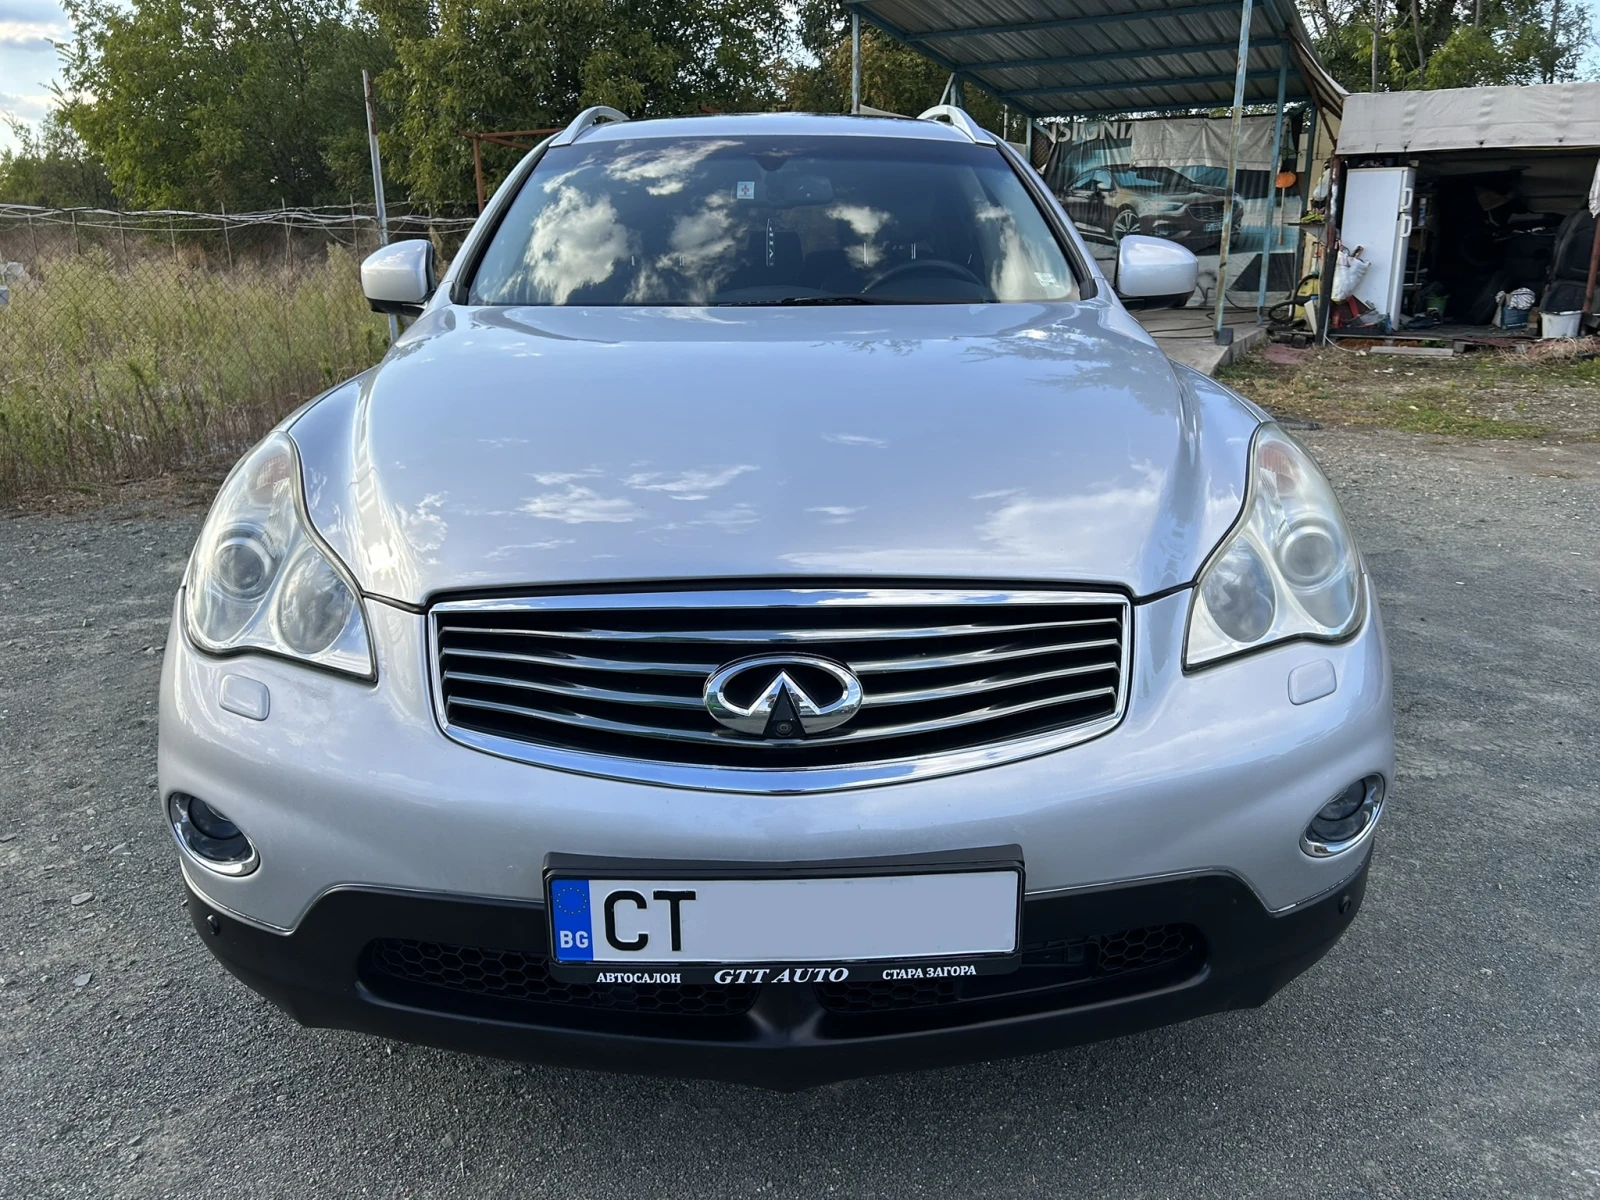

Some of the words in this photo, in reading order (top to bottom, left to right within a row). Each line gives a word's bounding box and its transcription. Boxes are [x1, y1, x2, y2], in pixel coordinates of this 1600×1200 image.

[604, 890, 697, 951] CT
[559, 930, 589, 948] BG
[596, 972, 681, 984] АВТОСАЛОН
[713, 968, 770, 984] GTT
[771, 967, 849, 983] AUTO
[882, 967, 923, 980] СТАРА
[926, 965, 977, 978] ЗАГОРА
